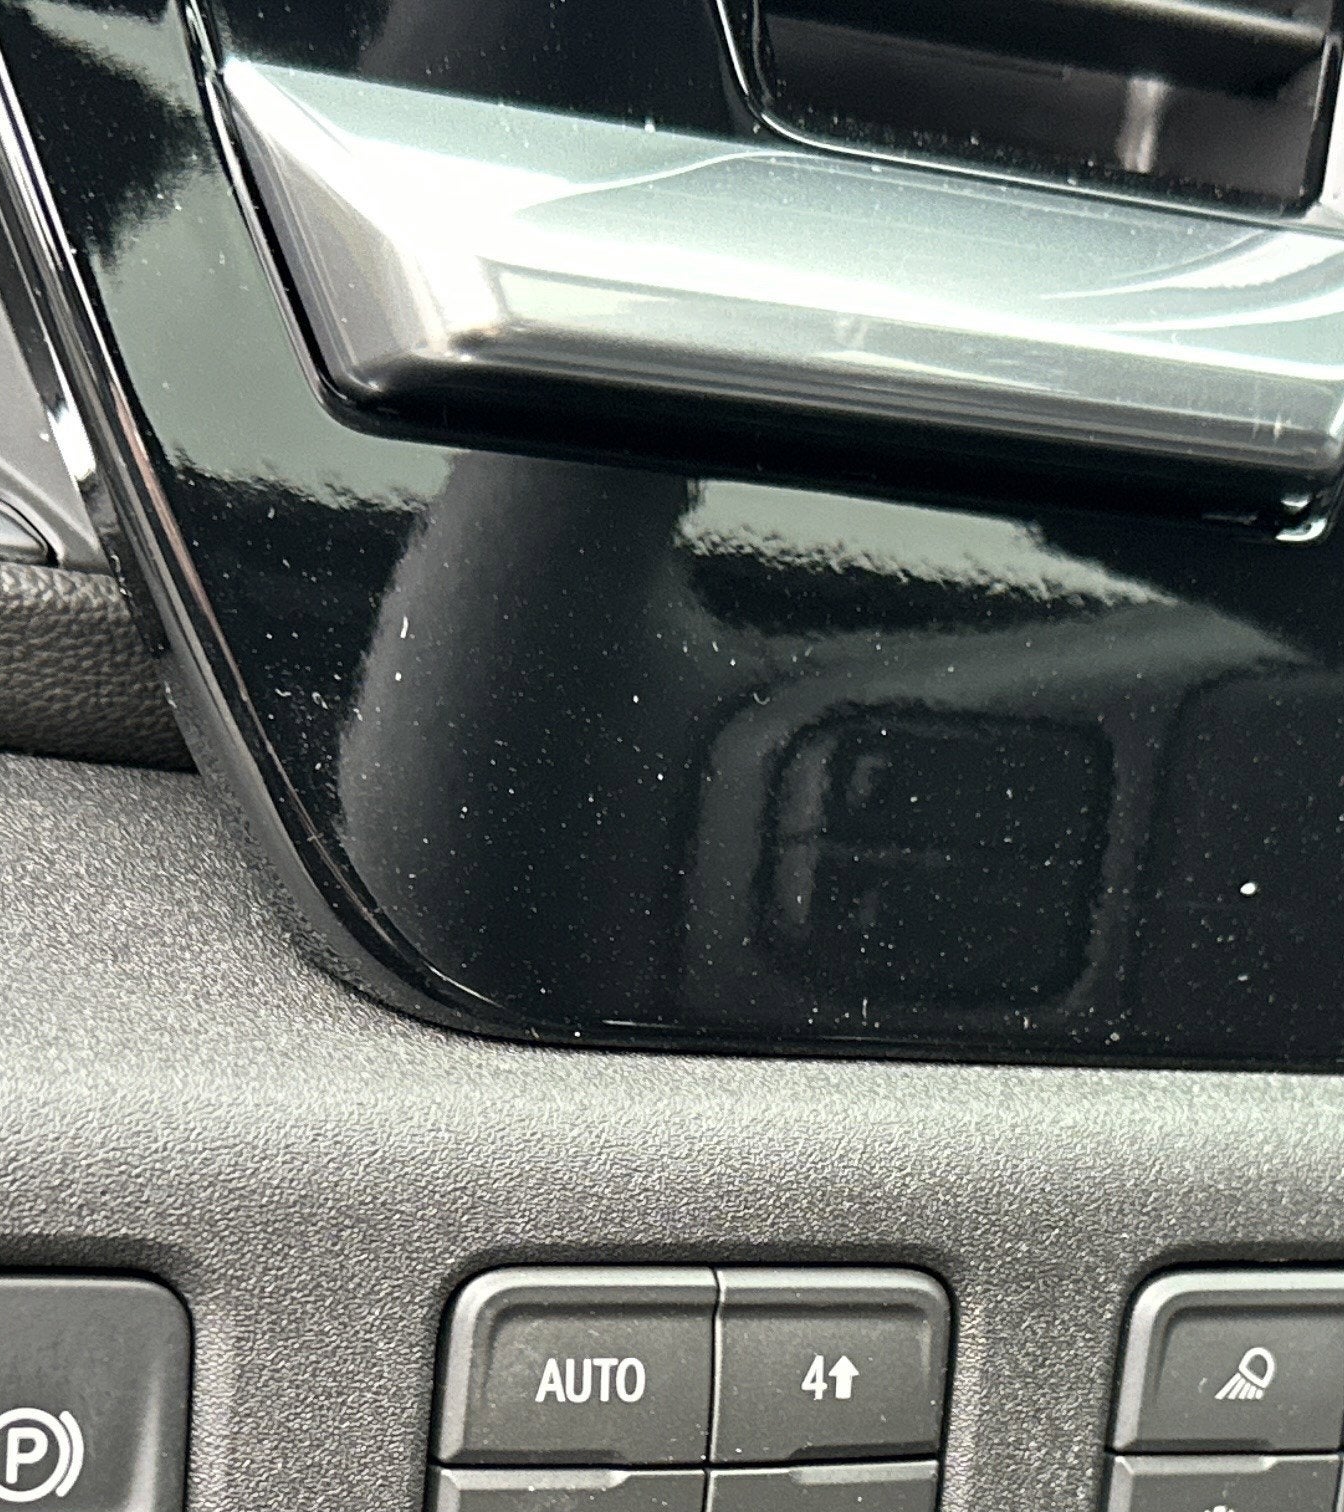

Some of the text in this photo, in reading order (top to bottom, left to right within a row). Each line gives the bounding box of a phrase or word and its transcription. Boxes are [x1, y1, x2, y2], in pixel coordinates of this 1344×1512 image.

[535, 1356, 646, 1403] AUTO
[801, 1354, 827, 1401] 4
[5, 1426, 49, 1484] P
